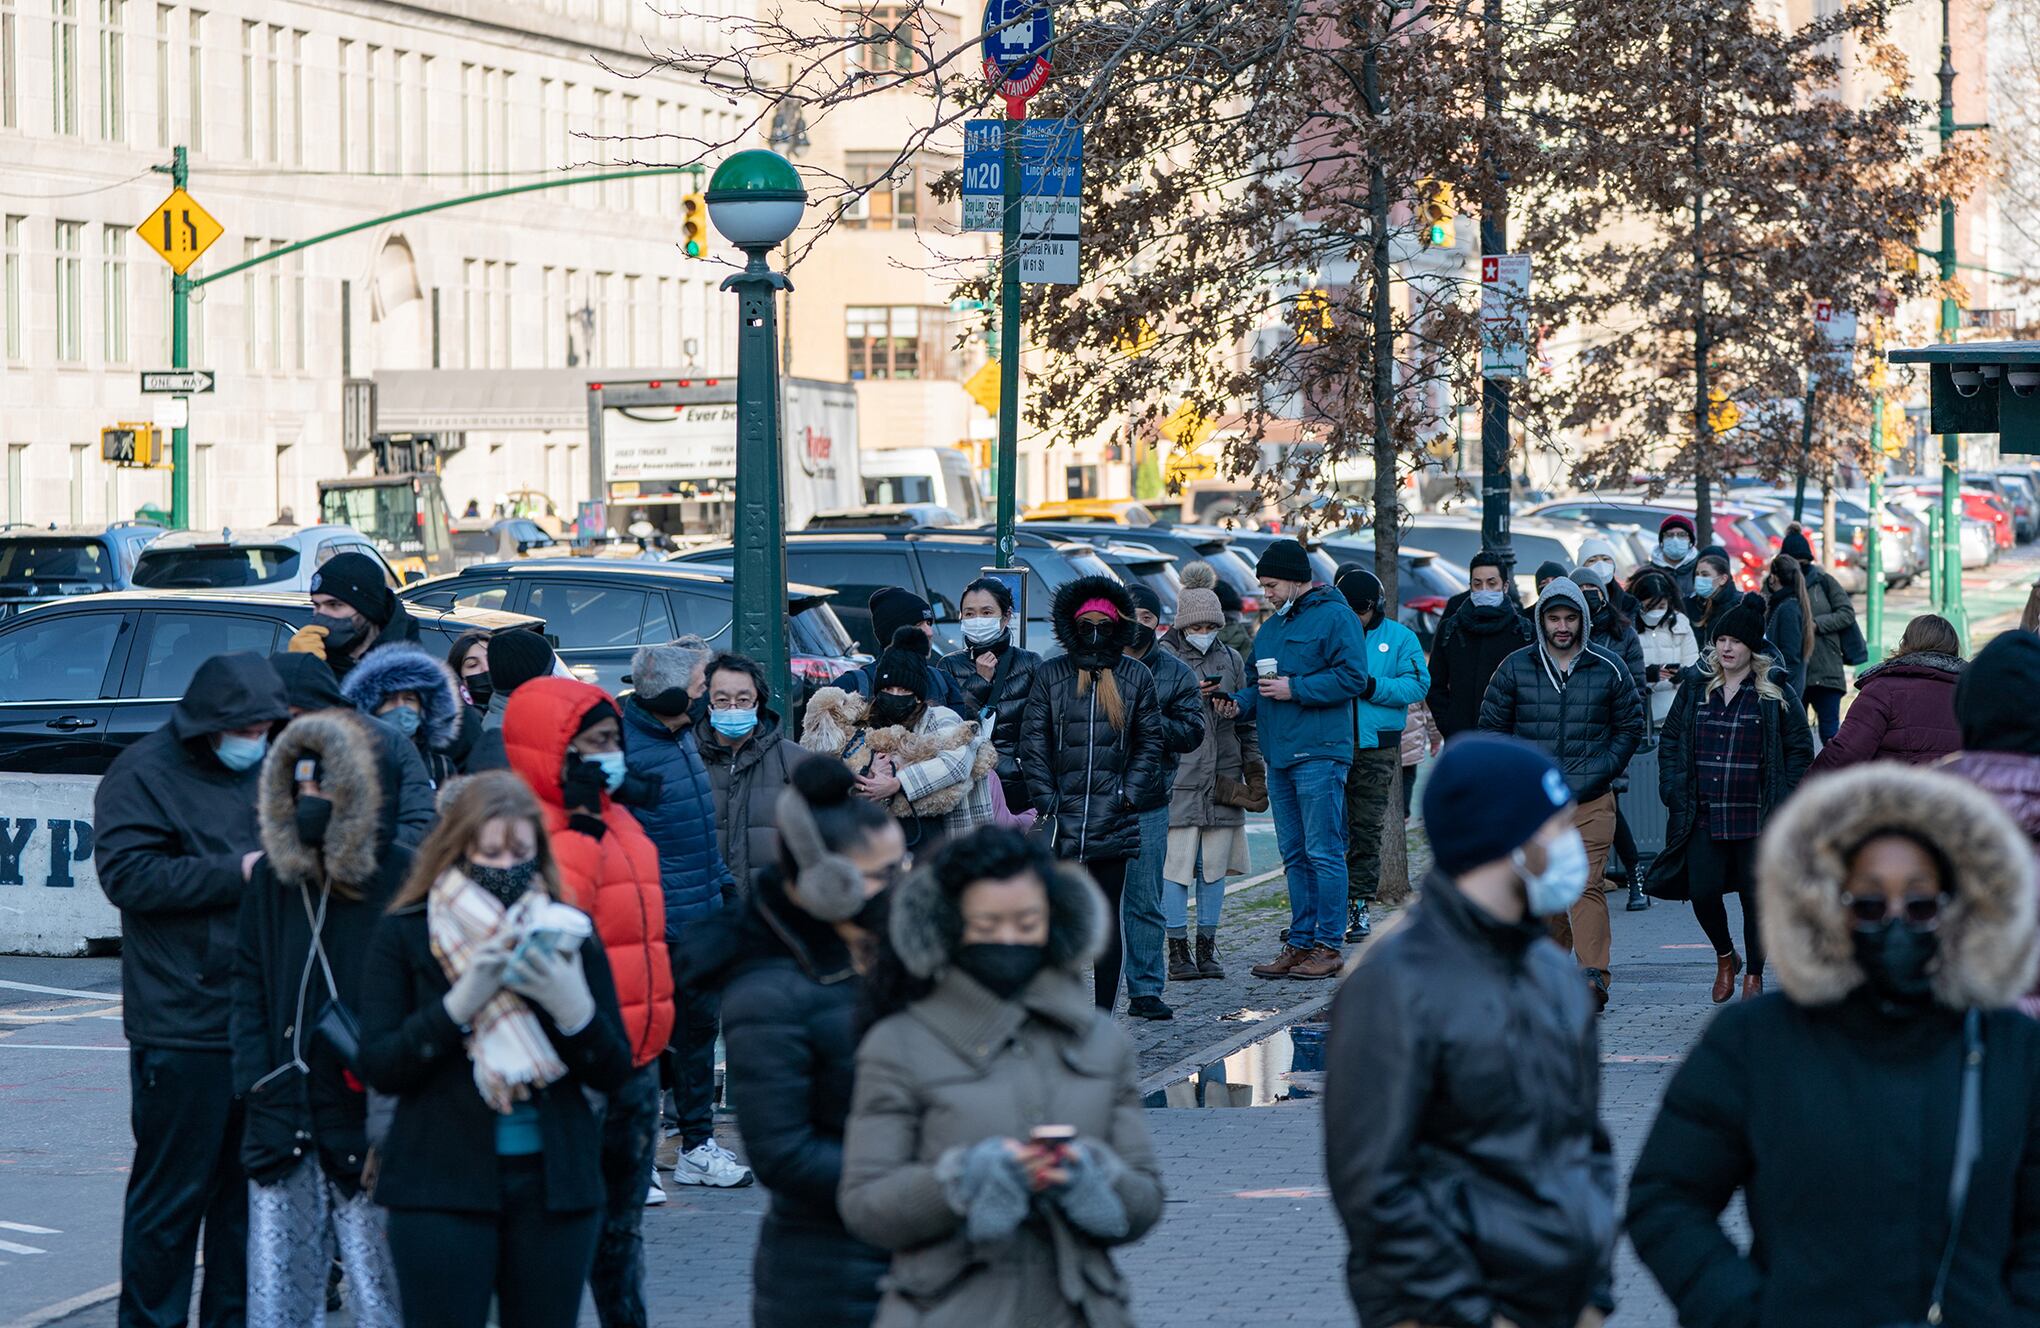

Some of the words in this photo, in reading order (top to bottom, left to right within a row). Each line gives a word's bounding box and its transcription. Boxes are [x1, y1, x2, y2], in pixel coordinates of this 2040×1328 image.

[967, 125, 1001, 152] M10
[966, 163, 1000, 190] M20
[1026, 164, 1051, 176] Linco
[1052, 166, 1076, 177] Ceer
[975, 199, 984, 212] Line
[987, 201, 999, 210] OUT
[1045, 202, 1056, 215] Dro
[1066, 202, 1078, 217] Only
[1044, 243, 1051, 255] Pk
[1052, 244, 1059, 255] W
[1060, 243, 1064, 256] &
[1023, 259, 1030, 271] W
[1030, 259, 1037, 271] 61
[1038, 259, 1045, 271] St
[151, 376, 171, 389] ONE
[182, 376, 204, 388] WAY
[687, 409, 717, 422] Ever
